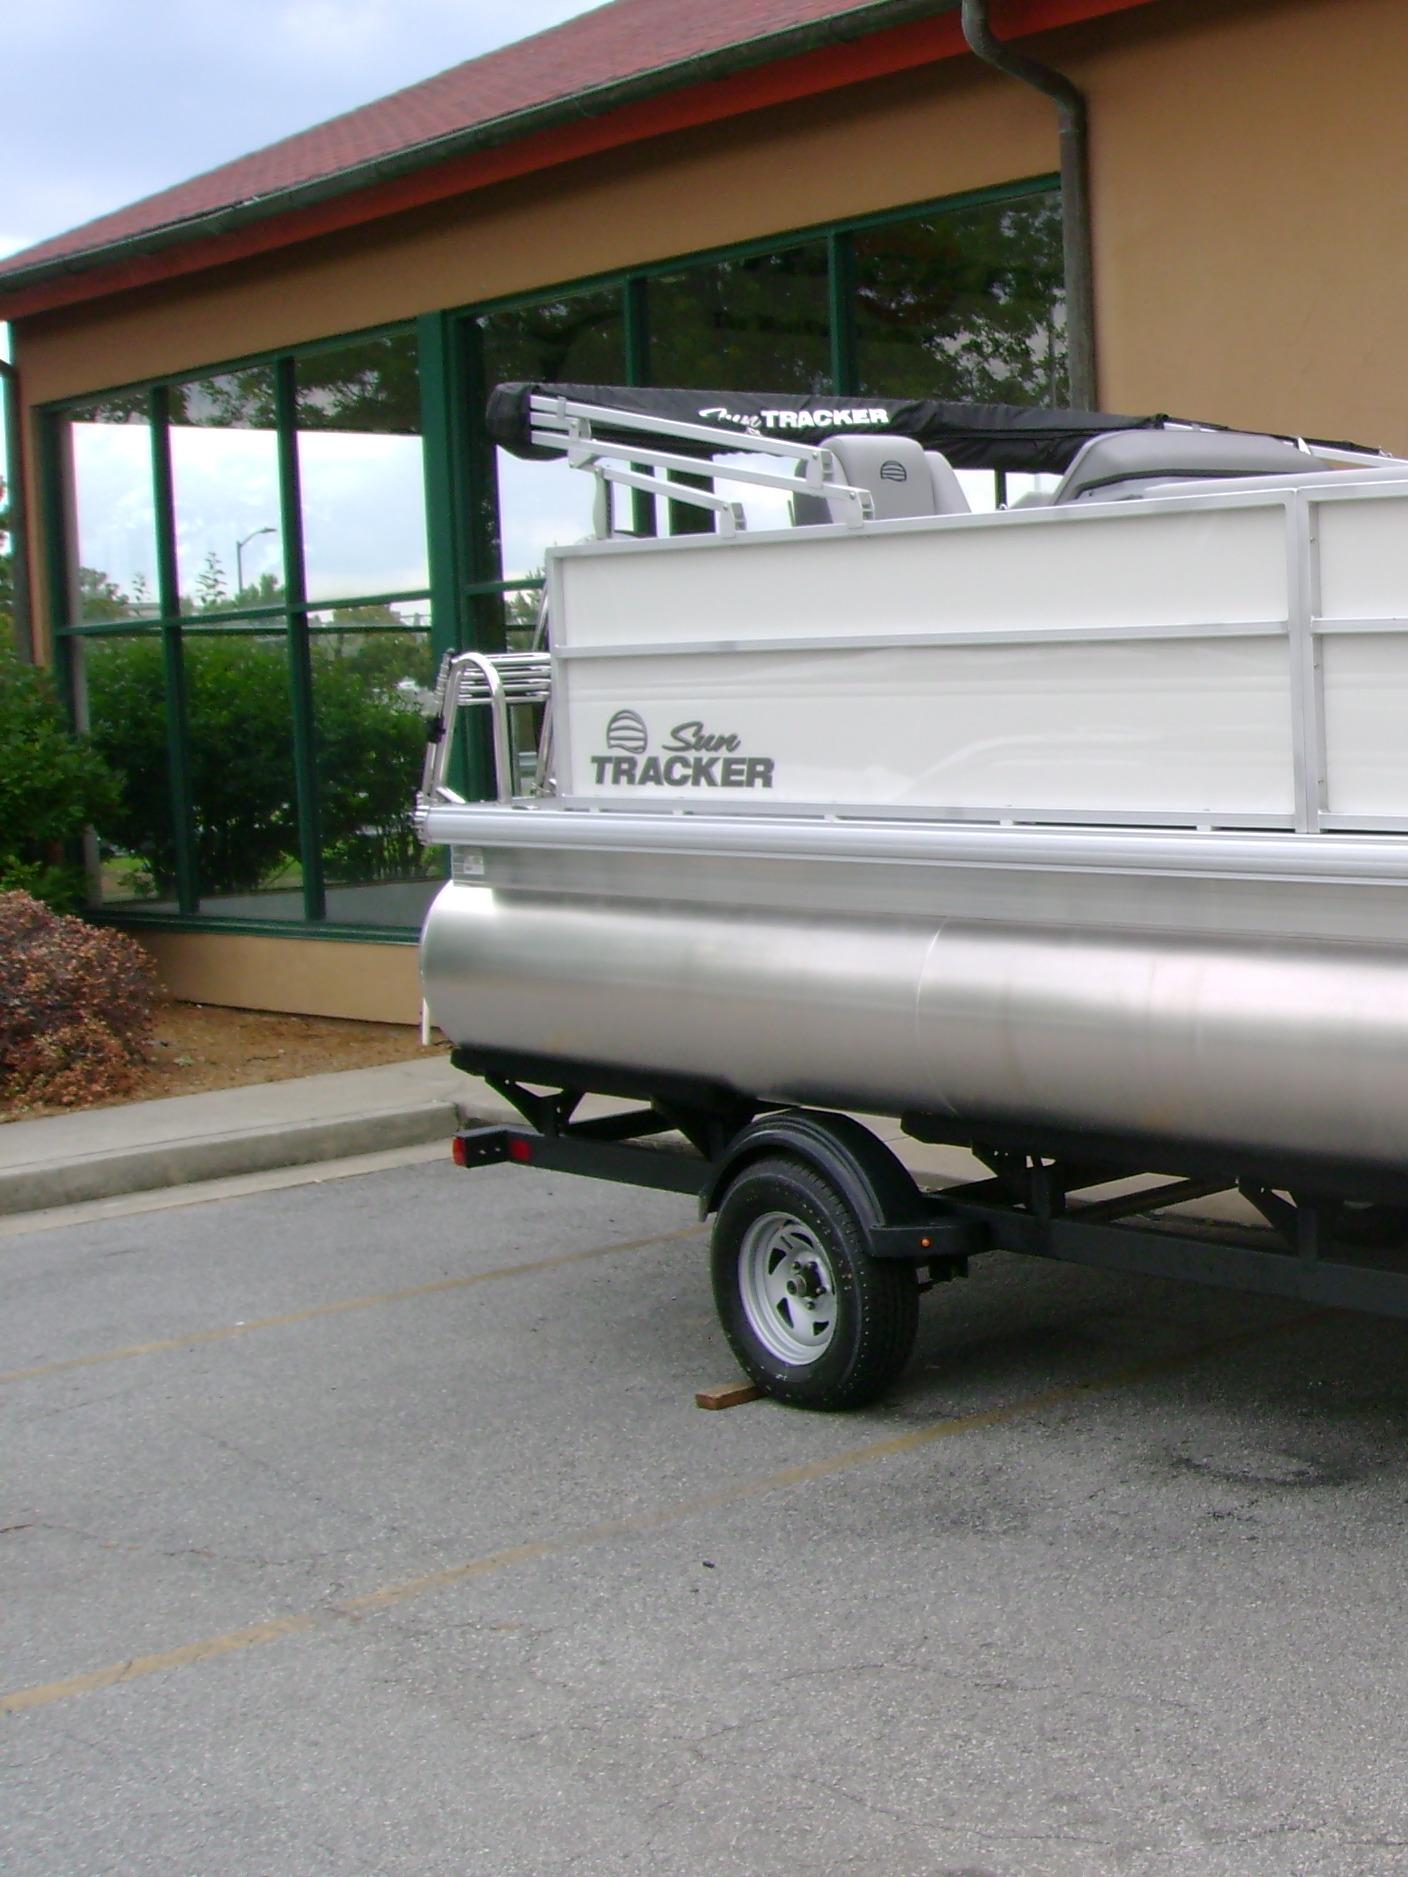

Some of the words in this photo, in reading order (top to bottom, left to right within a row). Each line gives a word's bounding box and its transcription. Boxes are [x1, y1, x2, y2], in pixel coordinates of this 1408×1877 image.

[760, 408, 889, 428] TRACKER
[662, 721, 741, 752] Sun
[591, 755, 775, 788] TRACKER
